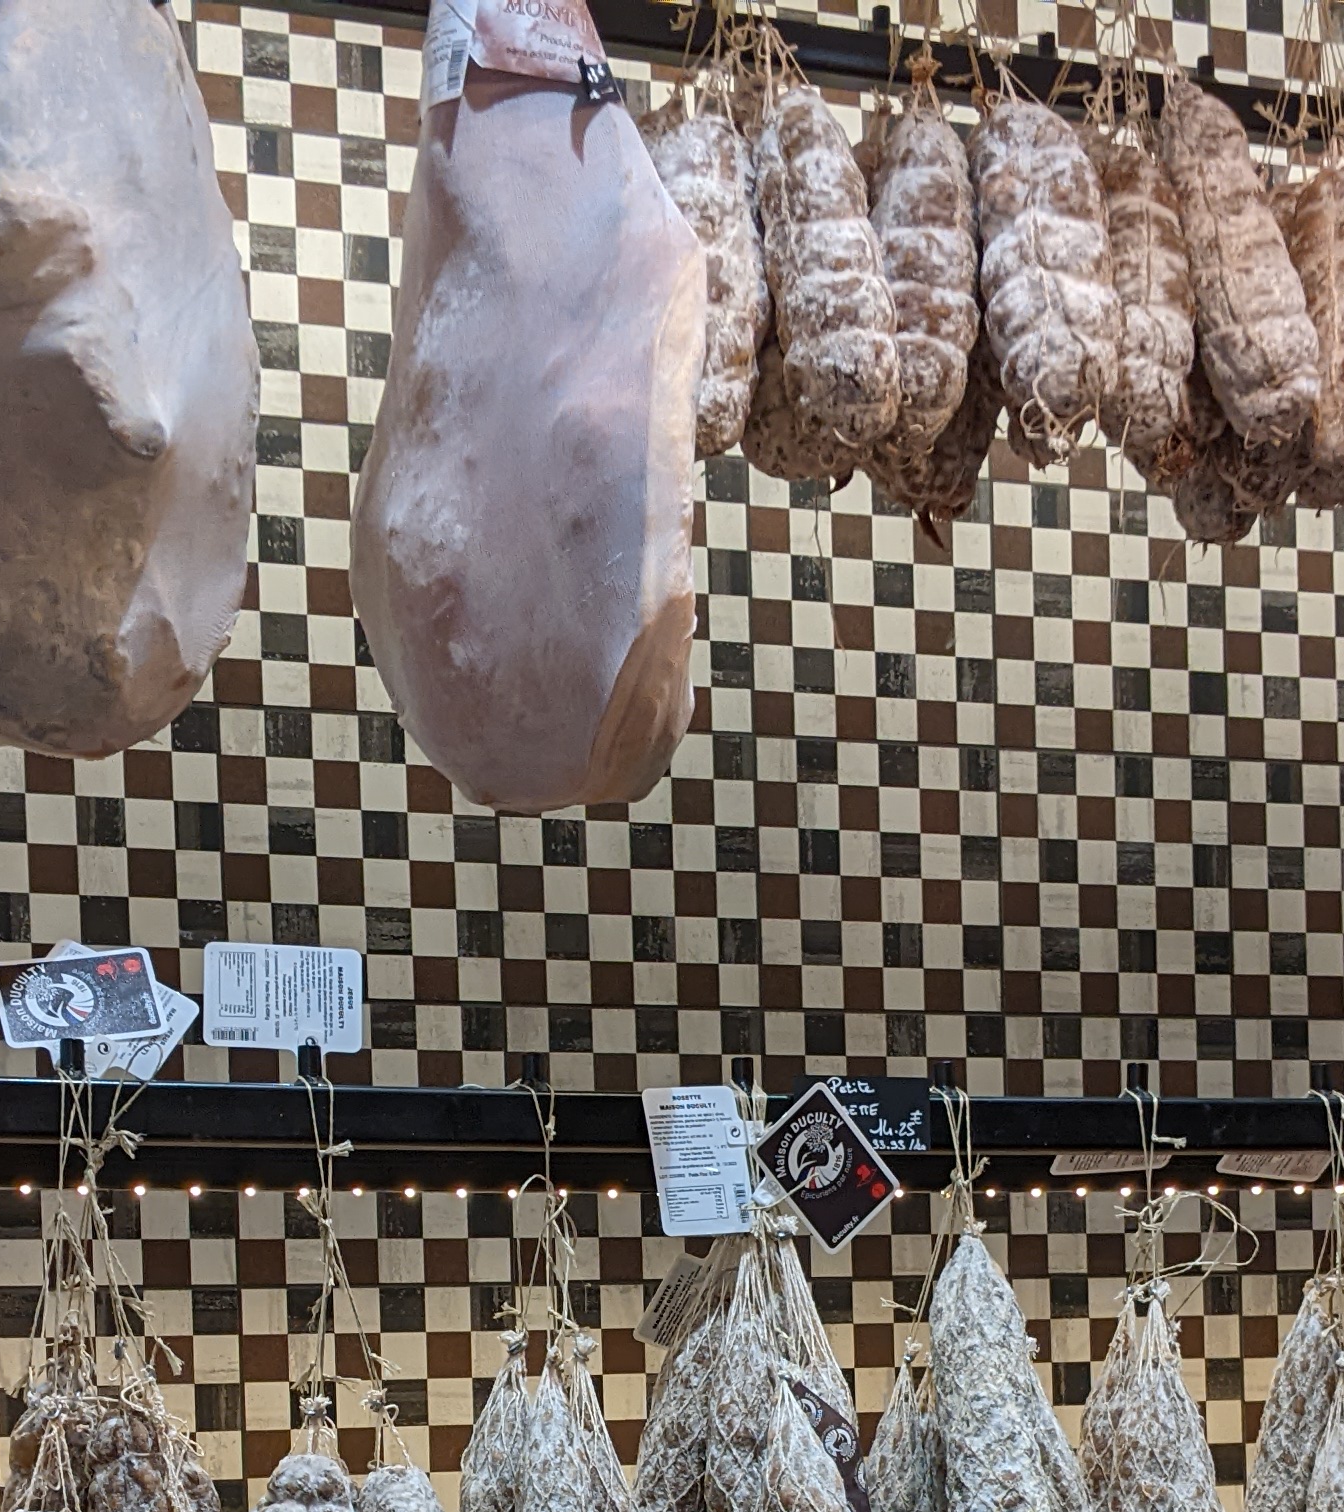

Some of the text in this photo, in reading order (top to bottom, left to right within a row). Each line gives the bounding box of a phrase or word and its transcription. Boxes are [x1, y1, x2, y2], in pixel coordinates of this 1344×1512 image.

[9, 963, 58, 1039] Maison DUCULTY
[826, 1077, 875, 1094] Petite
[774, 1111, 844, 1179] Maison DUCULTY
[832, 1215, 859, 1243] duculty.fr
